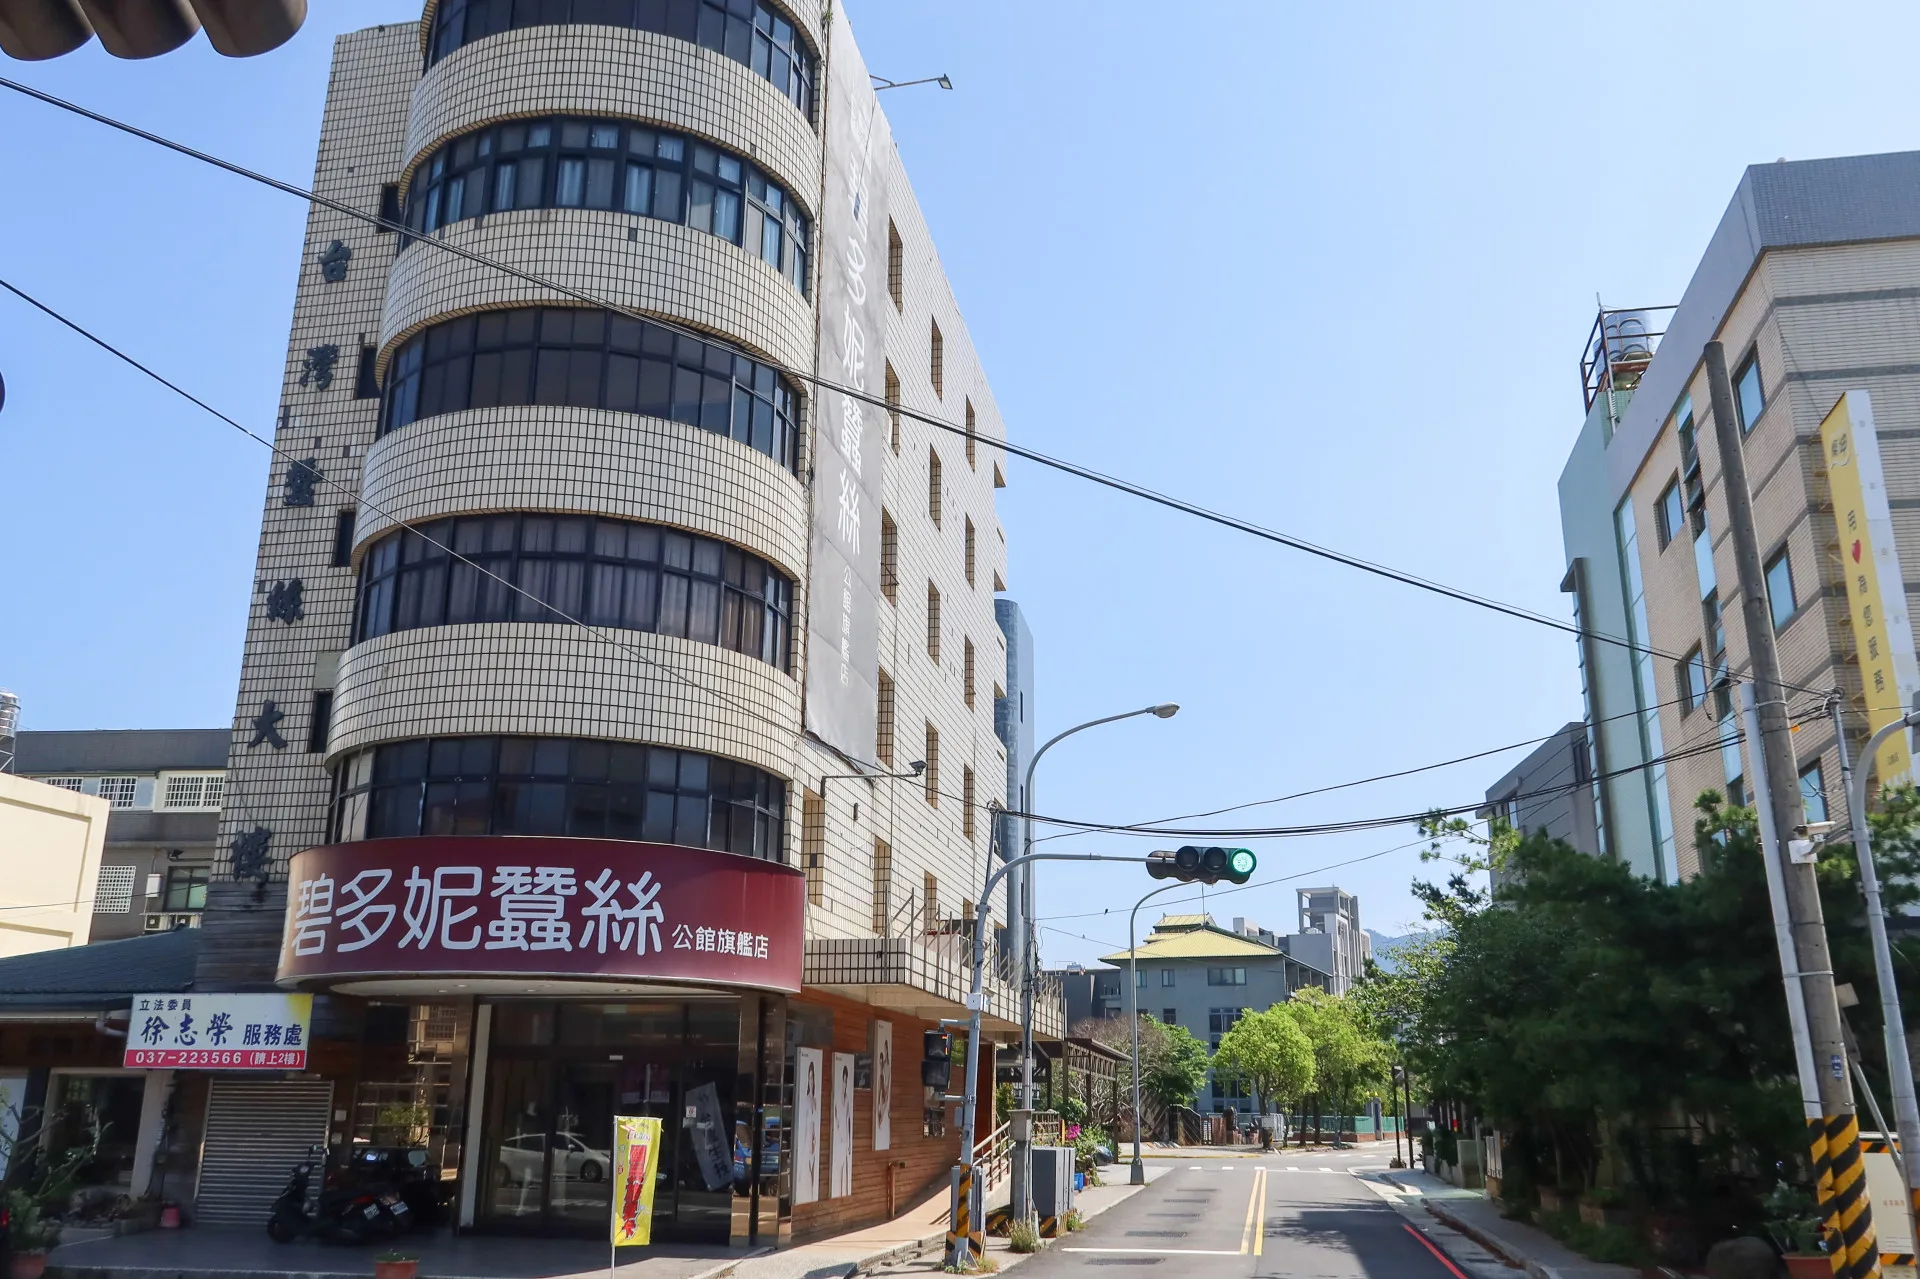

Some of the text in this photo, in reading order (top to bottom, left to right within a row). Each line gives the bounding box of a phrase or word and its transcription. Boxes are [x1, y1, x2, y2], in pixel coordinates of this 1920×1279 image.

[291, 866, 769, 960] 碧多妮蠶絲 公館旗艦店
[139, 999, 191, 1011] 立法委員
[141, 1012, 302, 1046] 徐志榮 服務處
[135, 1051, 242, 1064] 037-223566
